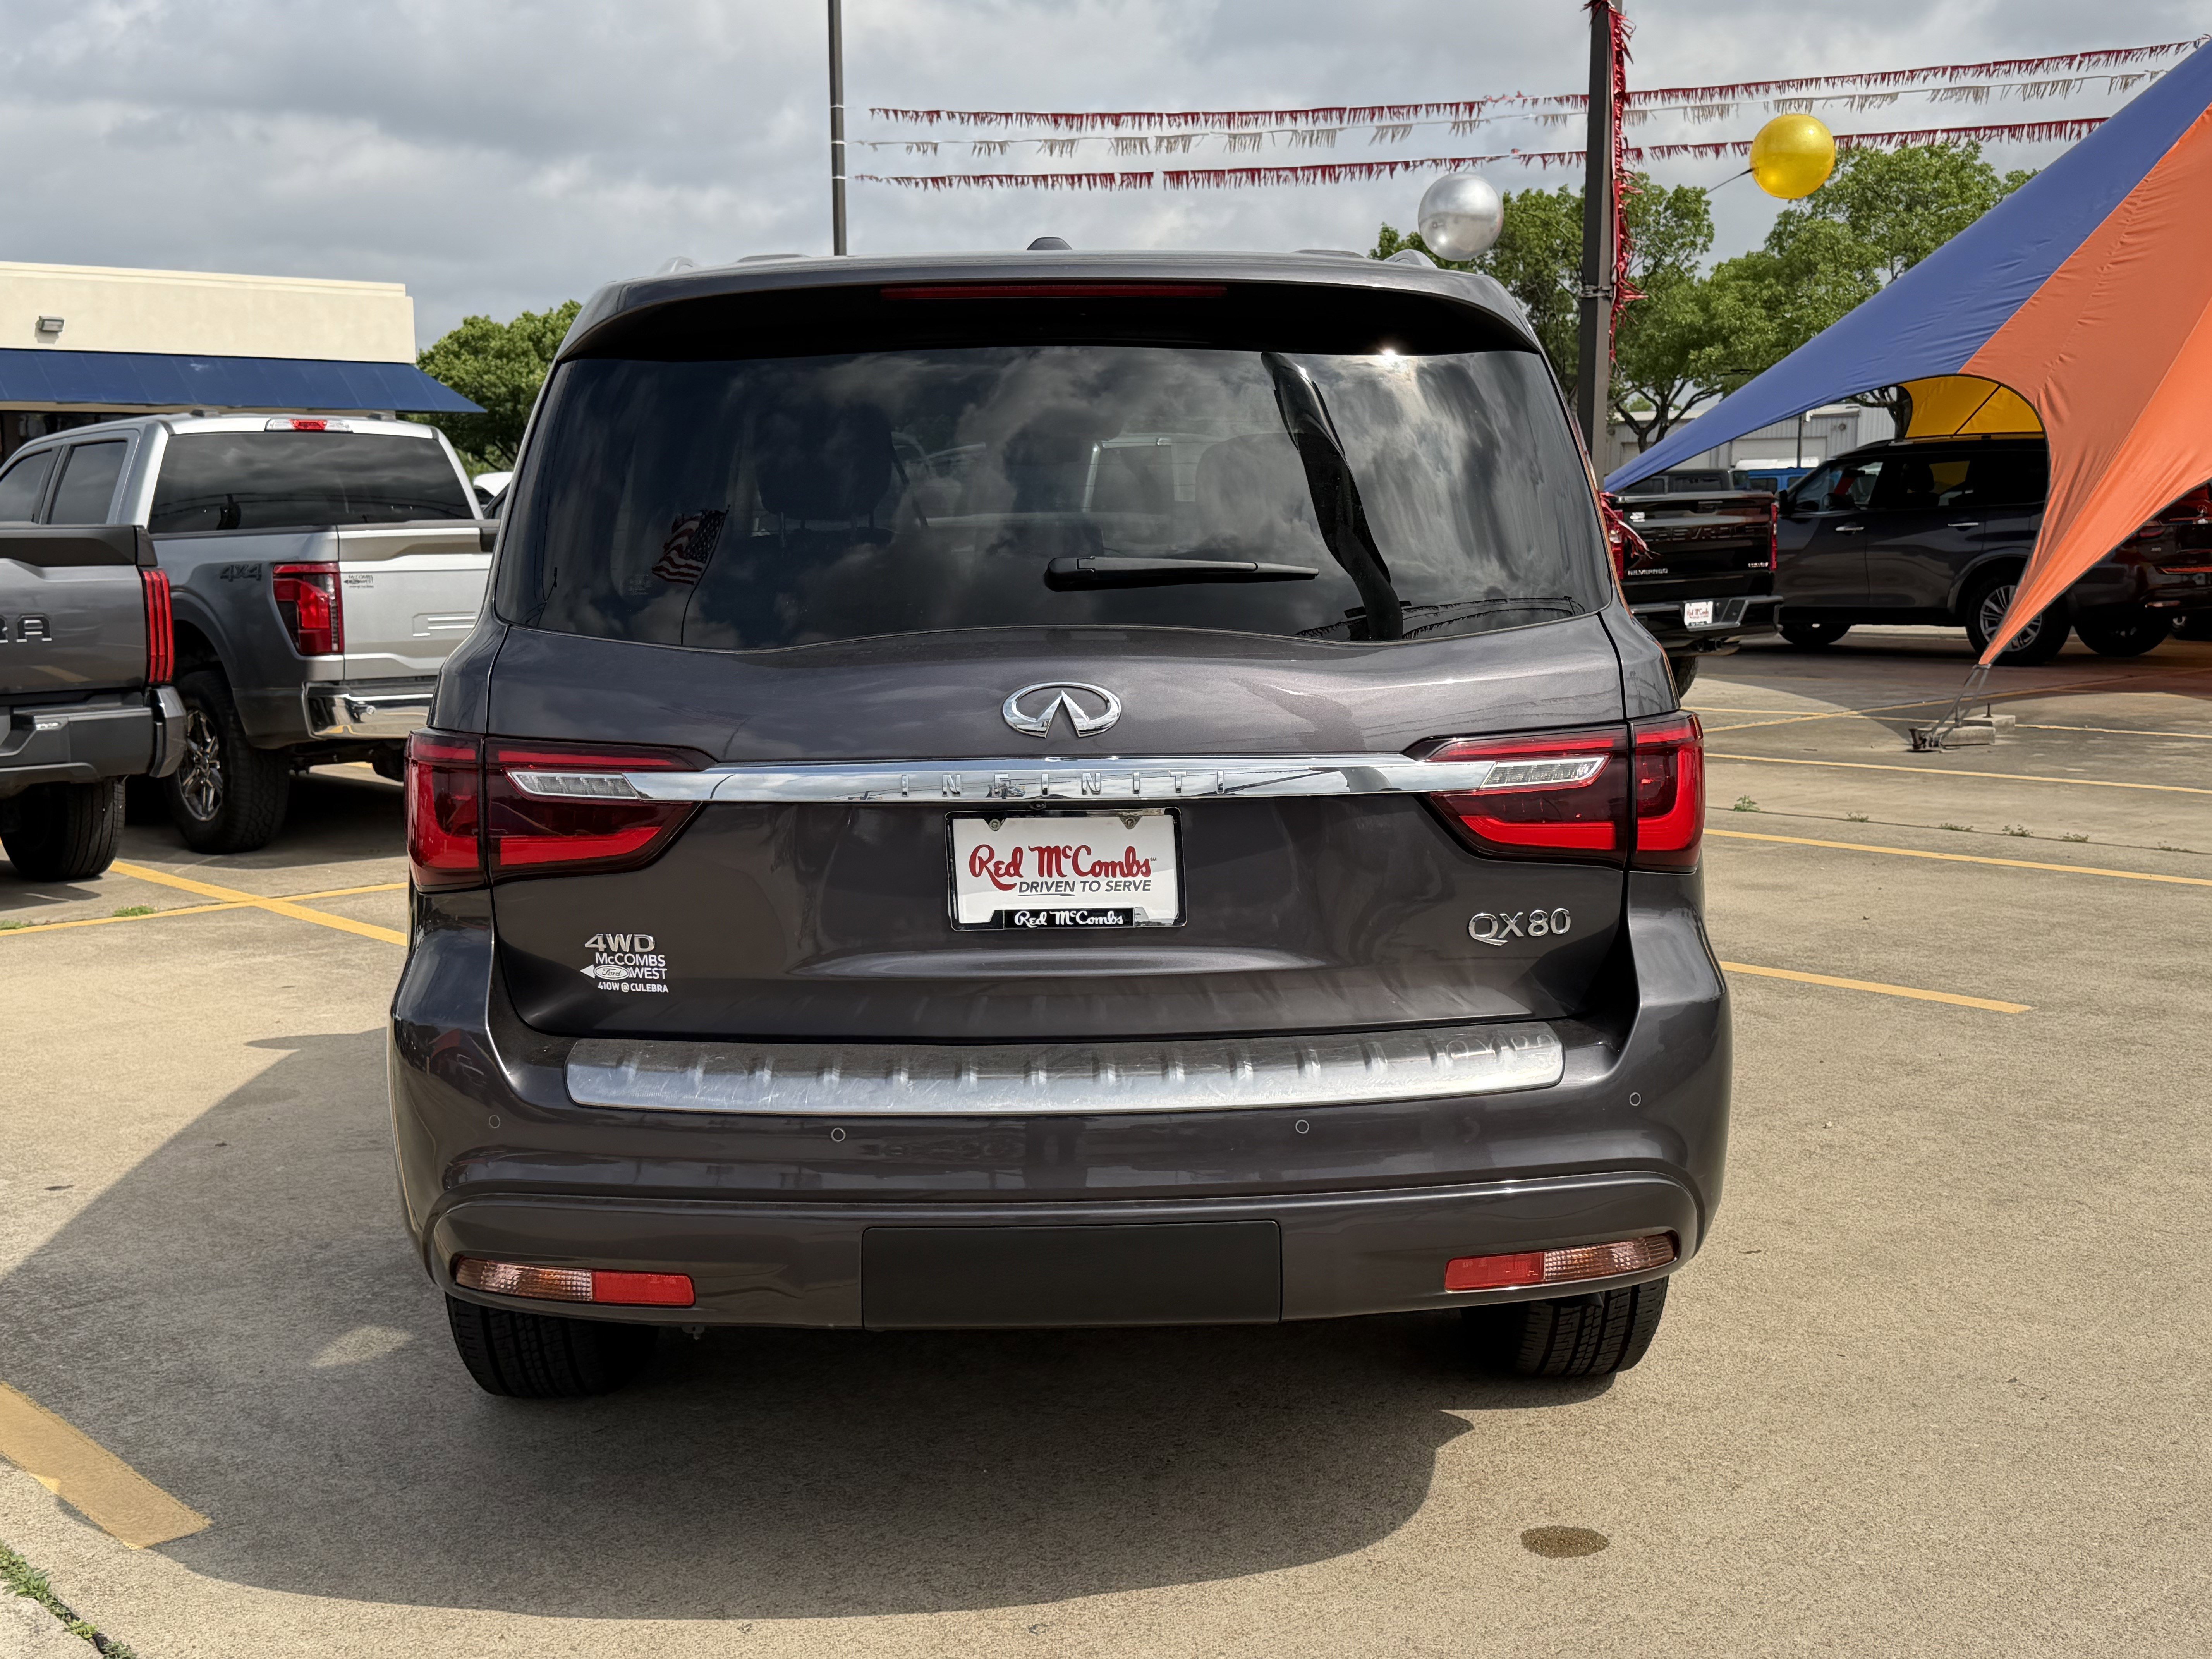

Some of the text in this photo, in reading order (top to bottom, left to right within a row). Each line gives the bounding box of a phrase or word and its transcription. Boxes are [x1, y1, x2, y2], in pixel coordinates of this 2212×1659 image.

[901, 770, 1226, 798] INFINITI
[969, 844, 1024, 891] Red
[1028, 845, 1151, 878] McCombs
[1018, 879, 1152, 893] DRIVEN TO SERVE
[1014, 910, 1124, 928] Red McCombs
[1468, 908, 1571, 946] QX80
[585, 933, 655, 952] 4WD
[595, 952, 666, 967] McCOMBS
[601, 967, 668, 980] Ford WEST
[598, 981, 669, 993] 410W @ CULEBRA
